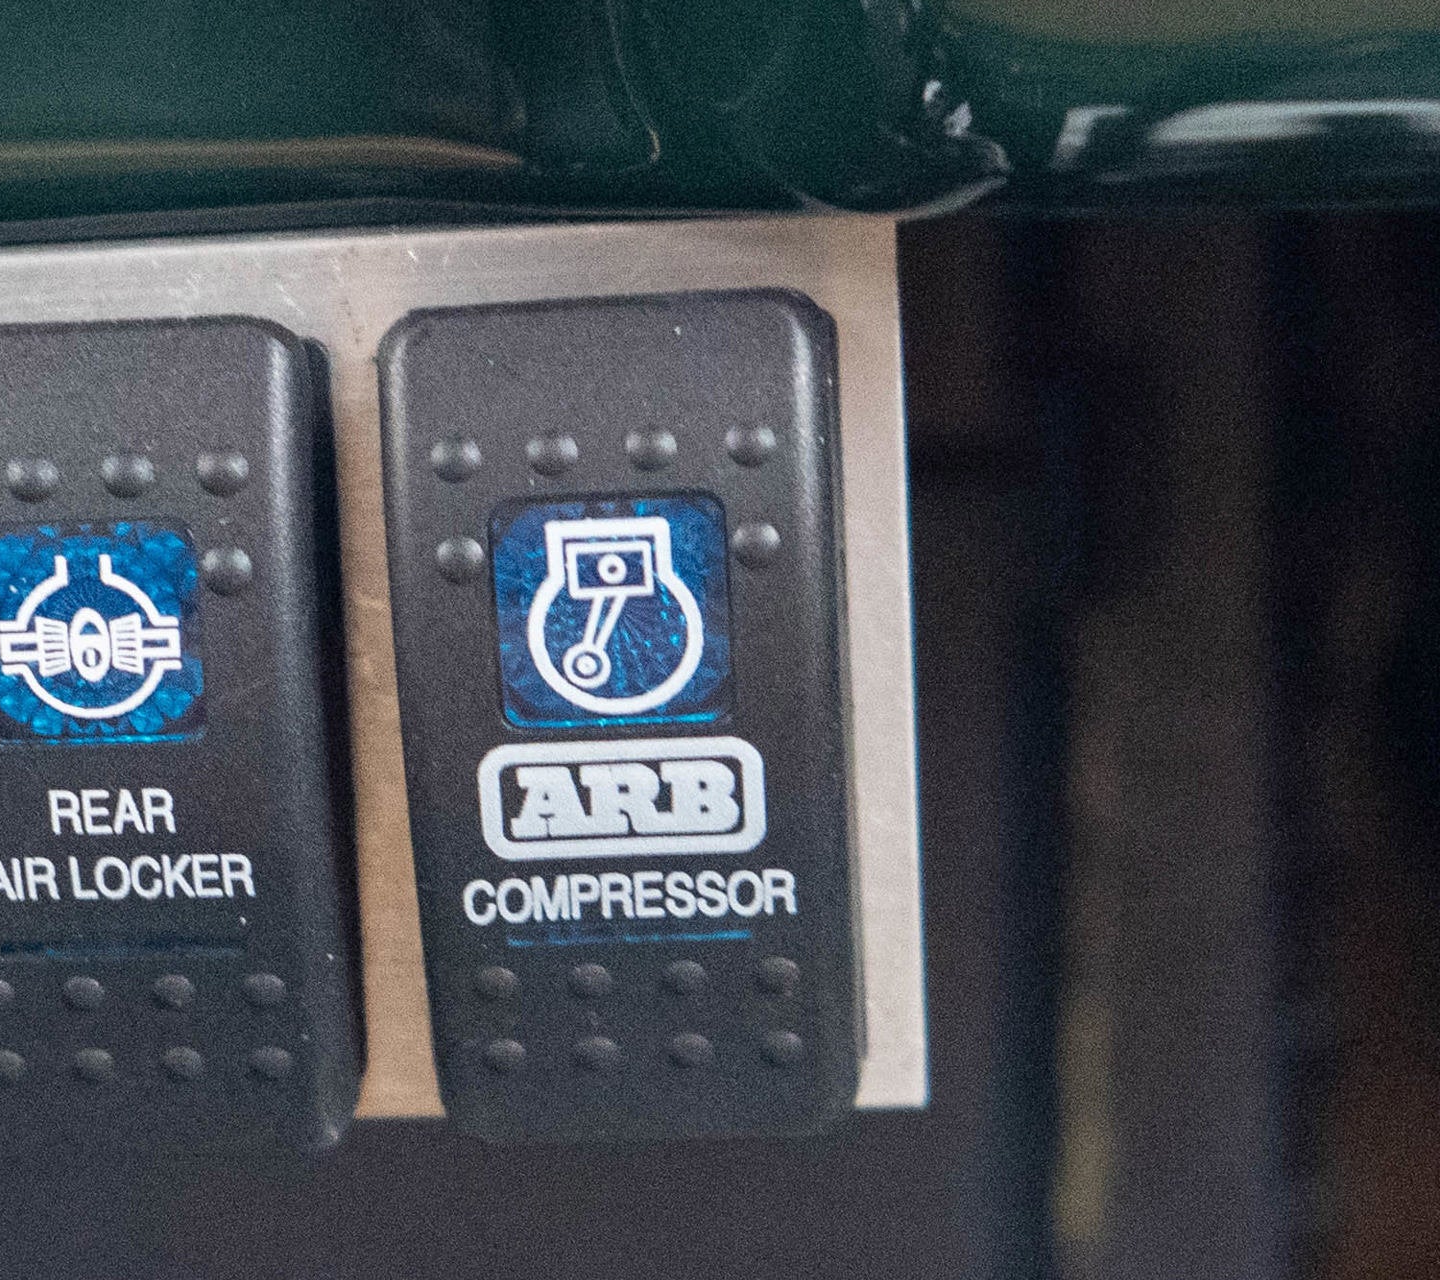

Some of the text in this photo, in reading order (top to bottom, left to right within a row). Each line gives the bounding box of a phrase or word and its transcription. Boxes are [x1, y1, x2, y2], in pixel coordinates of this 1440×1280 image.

[48, 787, 176, 836] REAR
[509, 761, 739, 838] ARB
[73, 853, 255, 901] LOCKER
[462, 868, 798, 926] COMPRESSOR
